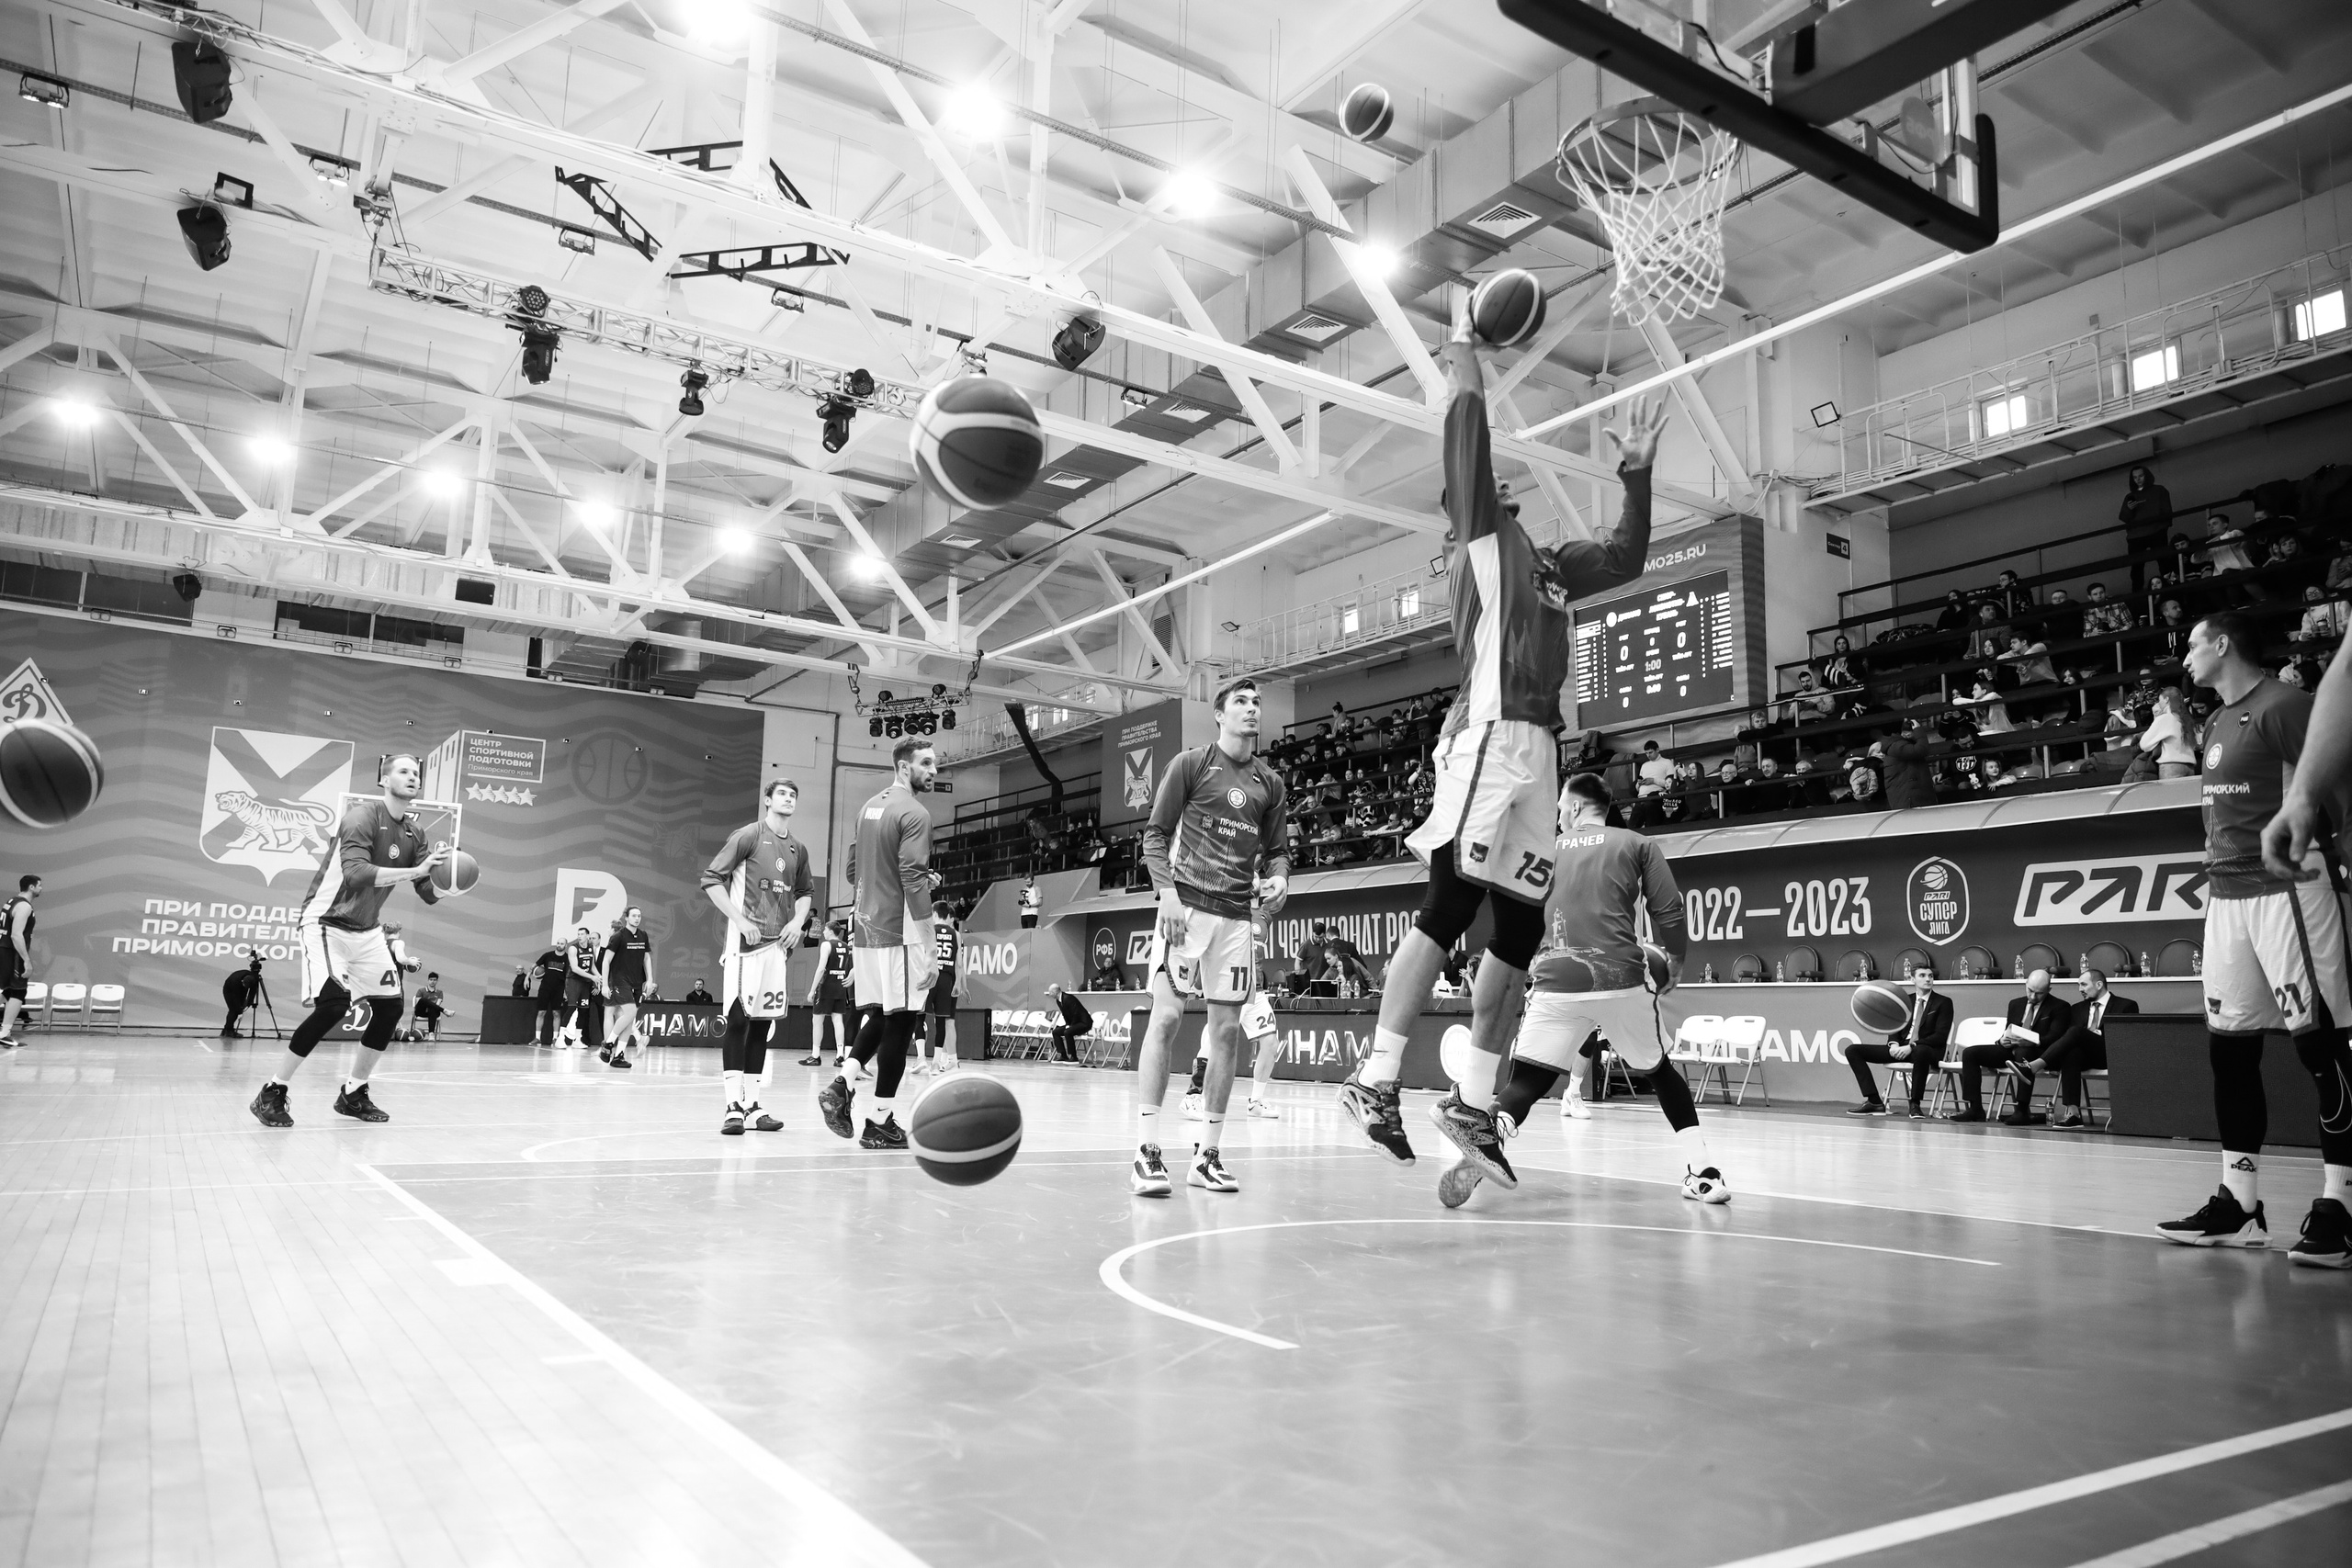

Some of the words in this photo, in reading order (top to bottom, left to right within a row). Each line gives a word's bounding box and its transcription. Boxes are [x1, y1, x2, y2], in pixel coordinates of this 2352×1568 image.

[1678, 632, 1686, 649] 0
[1620, 645, 1629, 661] 0
[1645, 659, 1662, 672] 1:00
[470, 738, 502, 748] ЦЕНТР
[469, 747, 534, 760] СПОРТИВНОЙ
[469, 754, 532, 768] ПОДГОТОВКИ
[468, 763, 515, 774] Приморского
[1217, 826, 1237, 838] КРАЙ
[1555, 834, 1605, 851] ГРАЧЕВ
[1514, 851, 1554, 888] 15
[144, 898, 201, 917] ПРИ
[1919, 901, 1958, 921] СУПЕР
[1928, 921, 1951, 935] ЛИГА
[1096, 942, 1114, 956] РФБ
[838, 954, 844, 968] 7
[1230, 966, 1248, 991] 11
[581, 998, 589, 1007] 24
[763, 990, 784, 1010] 29
[1256, 1012, 1276, 1030] 24
[2231, 1163, 2257, 1173] PEAK
